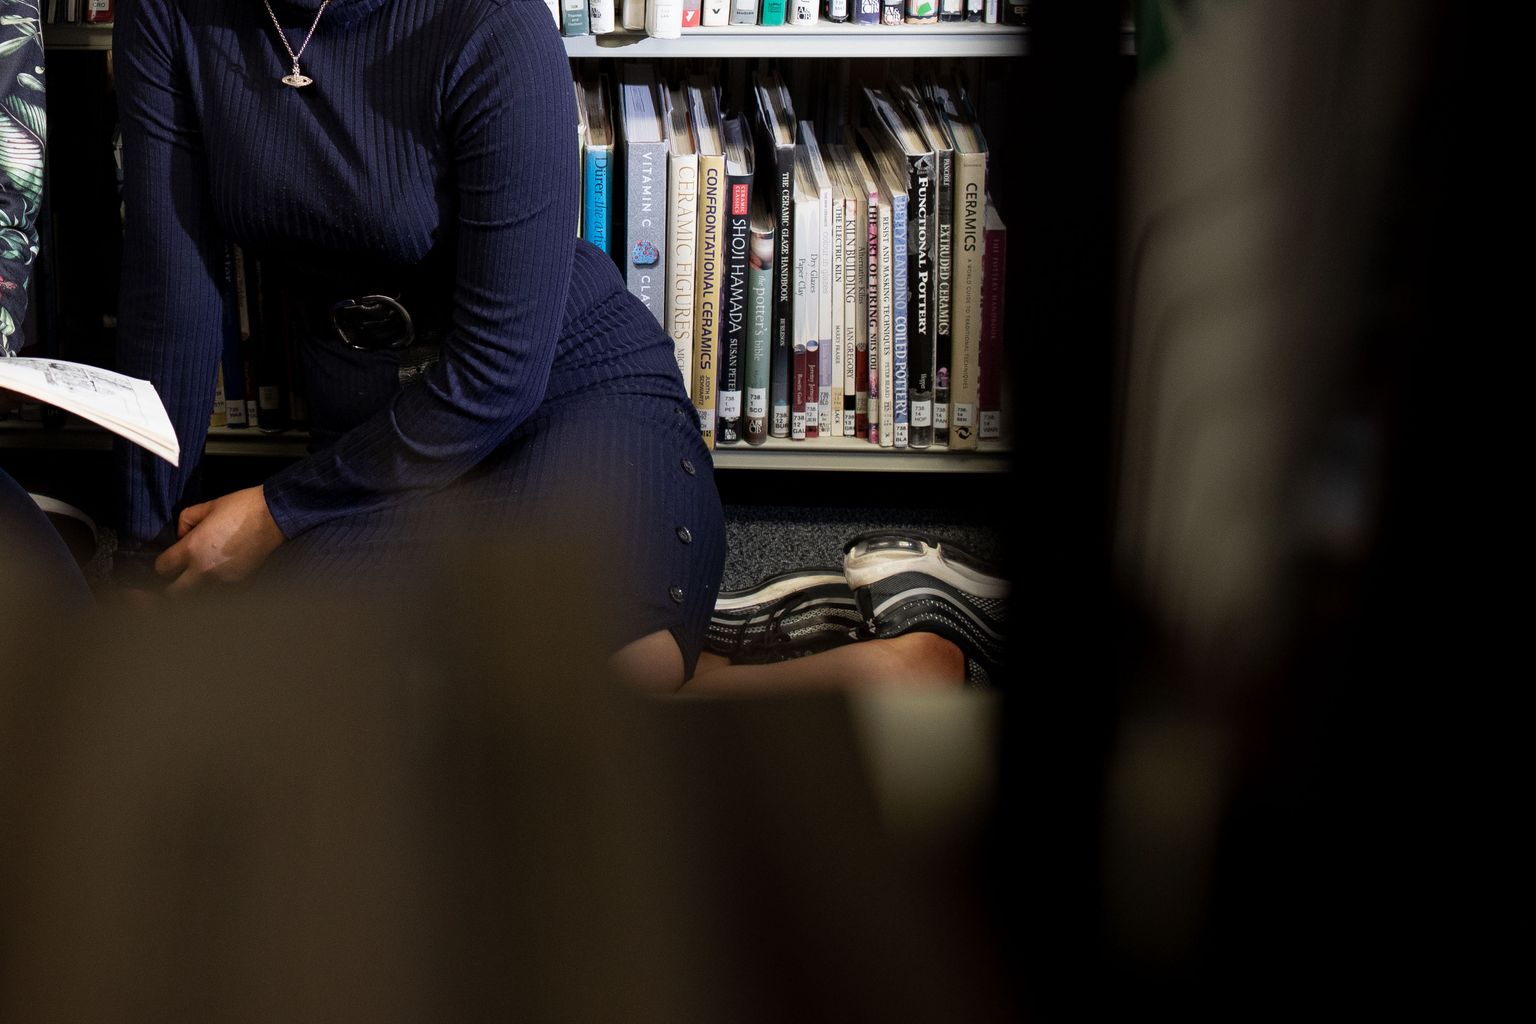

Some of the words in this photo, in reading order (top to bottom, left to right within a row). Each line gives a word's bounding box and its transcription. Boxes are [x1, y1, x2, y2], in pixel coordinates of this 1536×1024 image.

[641, 151, 653, 214] VITAMIN
[675, 165, 695, 257] CERAMIC
[702, 167, 719, 300] CONFRONTATIONAL
[731, 218, 747, 261] SHOJI
[917, 176, 930, 268] FUNCTIONAL
[963, 181, 979, 253] CERAMICS
[809, 269, 818, 294] Glazes
[810, 253, 819, 268] Dry
[674, 262, 693, 340] FIGURES
[728, 263, 745, 335] HAMADA
[917, 270, 929, 336] POTTERY
[700, 301, 714, 371] CERAMICS
[894, 316, 909, 361] COILED
[895, 362, 909, 418] POTTERY
